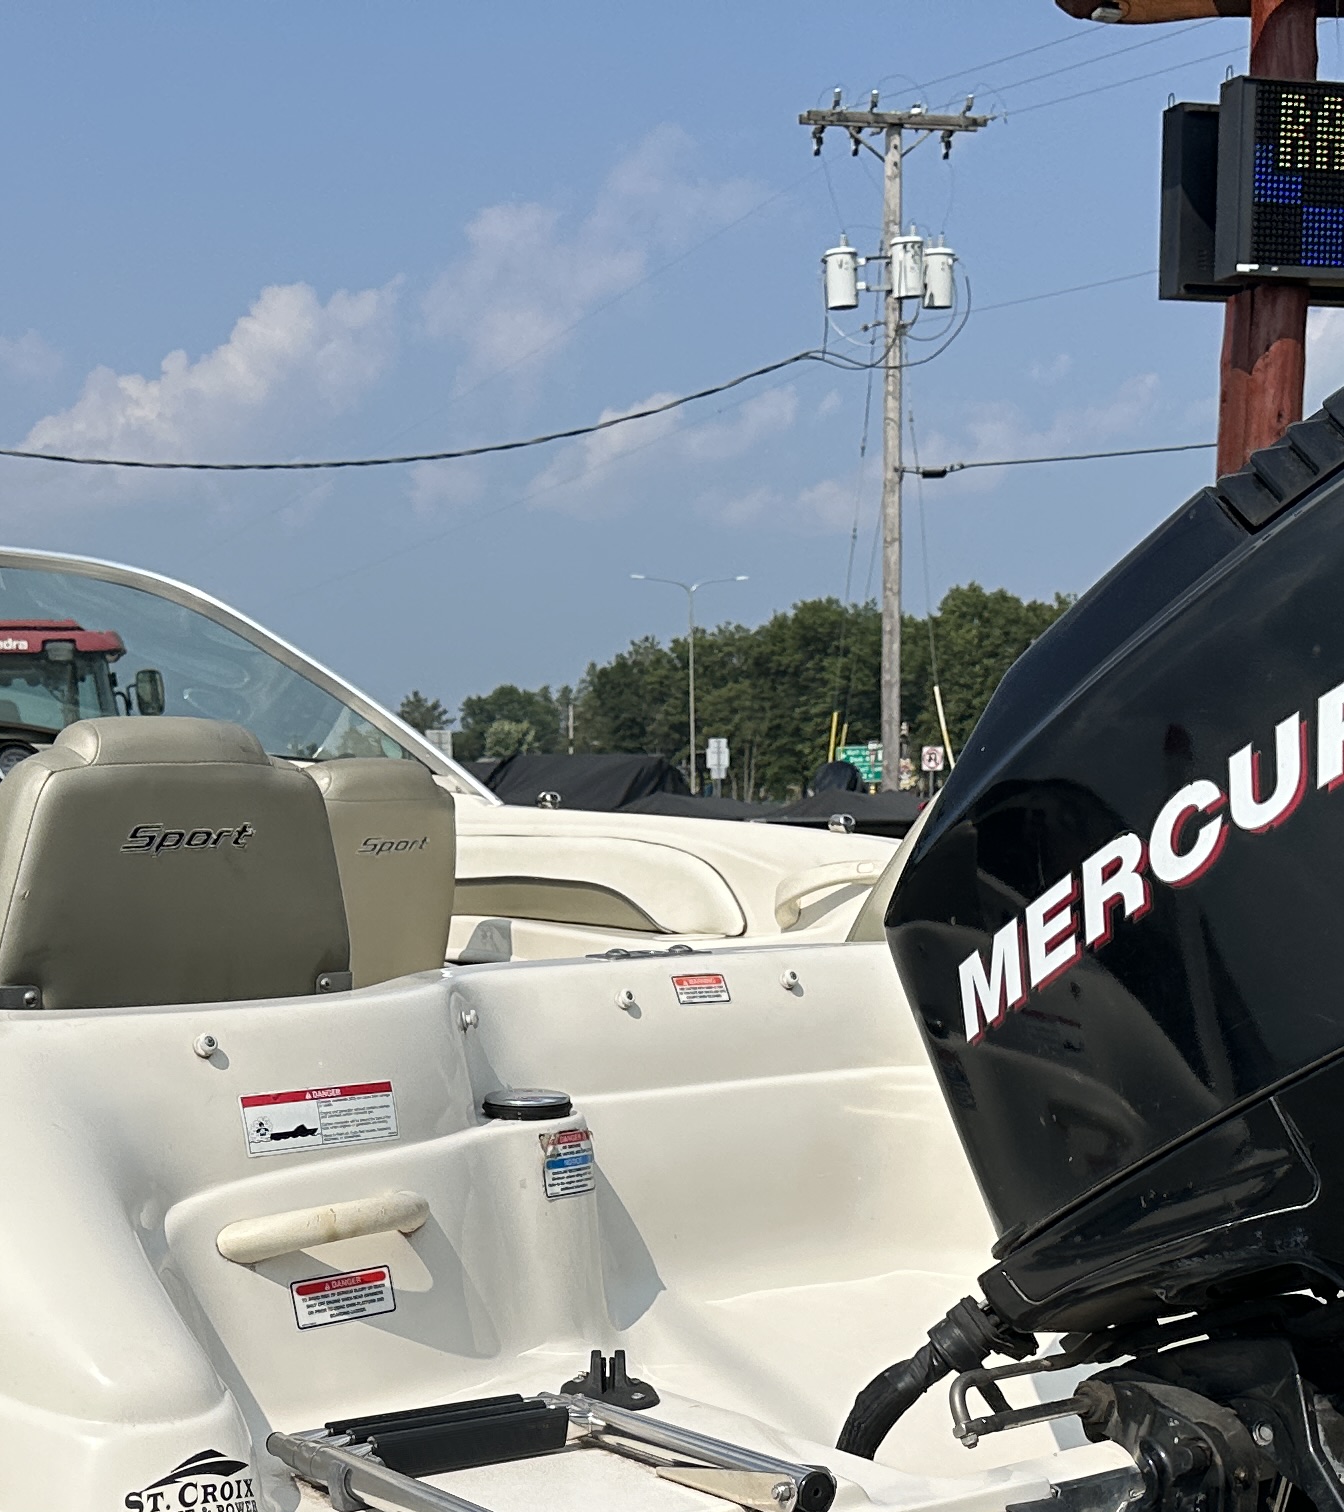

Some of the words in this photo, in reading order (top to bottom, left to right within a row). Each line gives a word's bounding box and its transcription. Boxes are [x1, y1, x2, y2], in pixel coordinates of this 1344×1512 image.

[120, 821, 257, 858] Sport
[357, 836, 430, 856] Sport
[312, 1088, 342, 1099] DANGER
[331, 1276, 362, 1289] DANGER
[178, 1479, 255, 1508] CROIX
